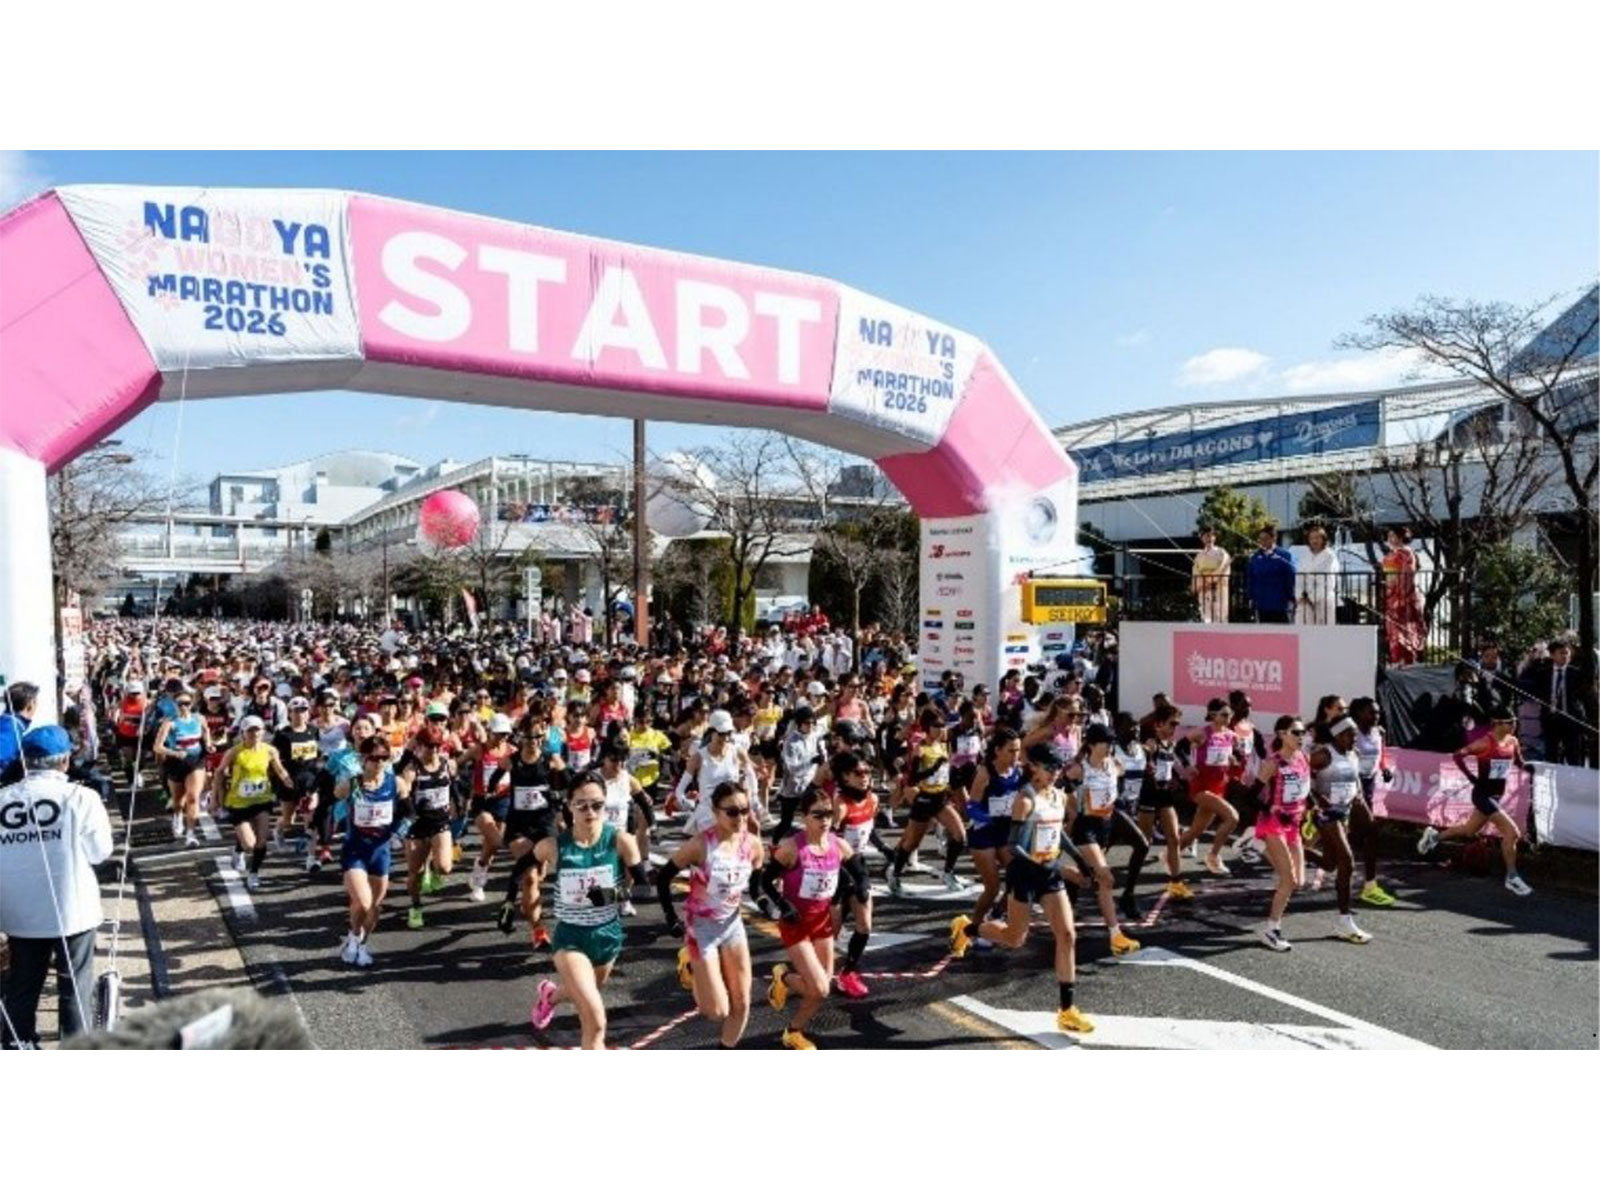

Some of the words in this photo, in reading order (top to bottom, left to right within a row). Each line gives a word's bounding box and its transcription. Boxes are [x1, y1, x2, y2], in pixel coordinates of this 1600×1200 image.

[148, 273, 334, 315] MARATHON
[202, 304, 287, 337] 2026
[377, 231, 822, 386] START
[857, 368, 954, 399] MARATHON
[884, 390, 927, 413] 2026
[1170, 435, 1254, 461] DRAGONS
[1048, 607, 1095, 622] SEIKO
[1194, 657, 1282, 682] NAGOYA
[0, 799, 61, 829] GO
[0, 829, 62, 845] WOMEN
